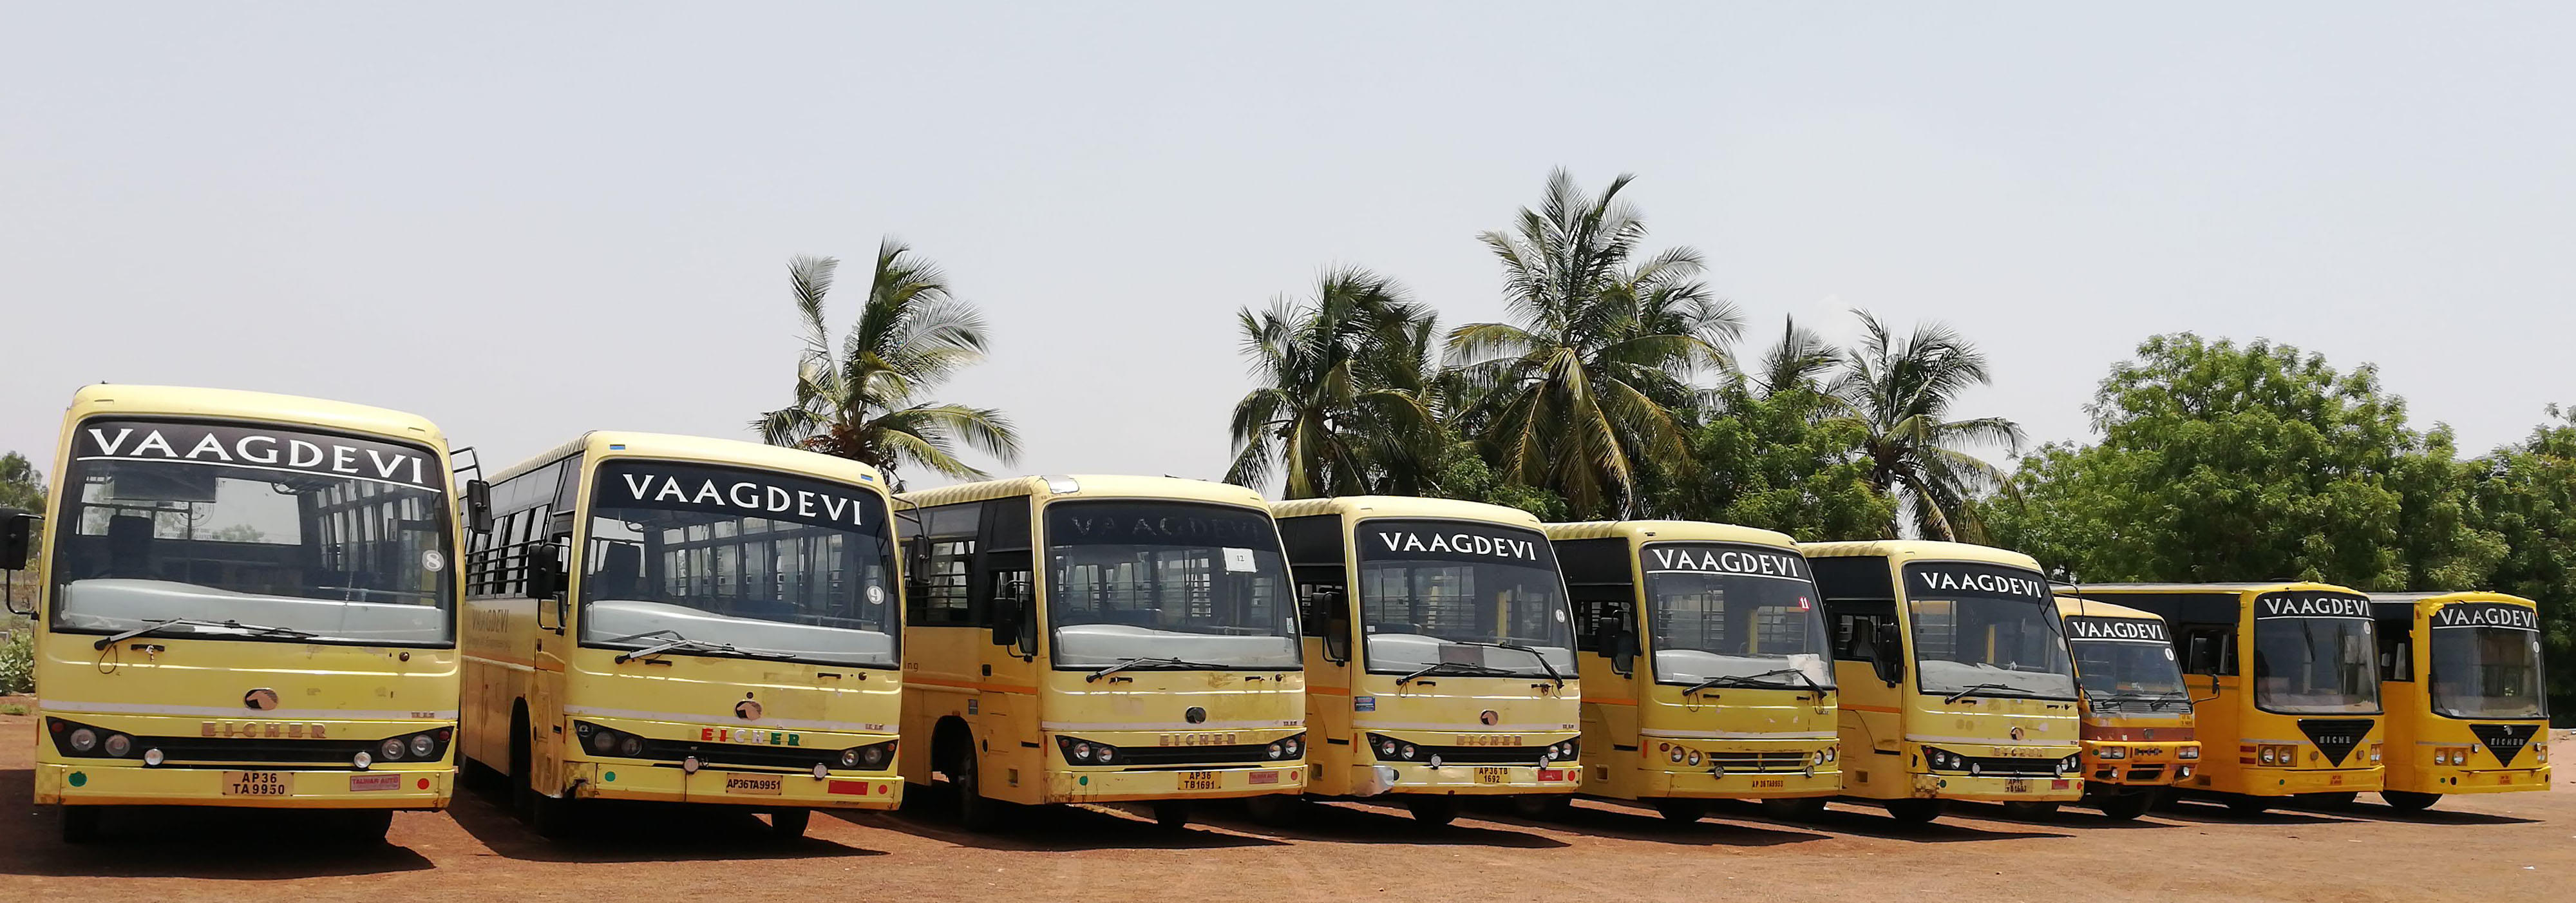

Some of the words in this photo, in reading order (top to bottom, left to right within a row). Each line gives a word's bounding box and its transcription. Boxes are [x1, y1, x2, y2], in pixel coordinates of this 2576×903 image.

[88, 428, 423, 484] VAAGDEVI
[623, 473, 862, 526] VAAGDEVI
[1379, 532, 1537, 560] VAAGDEVI
[426, 553, 441, 569] 8
[1653, 549, 1799, 577] VAAGDEVI
[1920, 572, 2042, 598] VAAGDEVI
[2264, 598, 2371, 616] VAAGDEVI
[2439, 608, 2537, 628] VAAGDEVI
[2072, 622, 2164, 640] VAAGDEVI
[202, 722, 326, 738] EICHER
[701, 728, 800, 746] EICHER
[1160, 733, 1236, 745] EICHER
[242, 772, 277, 783] AP36
[726, 779, 781, 790] AP36TA9951
[1184, 781, 1215, 789] TB1691
[1484, 775, 1500, 783] 1692
[232, 783, 285, 795] TA9950
